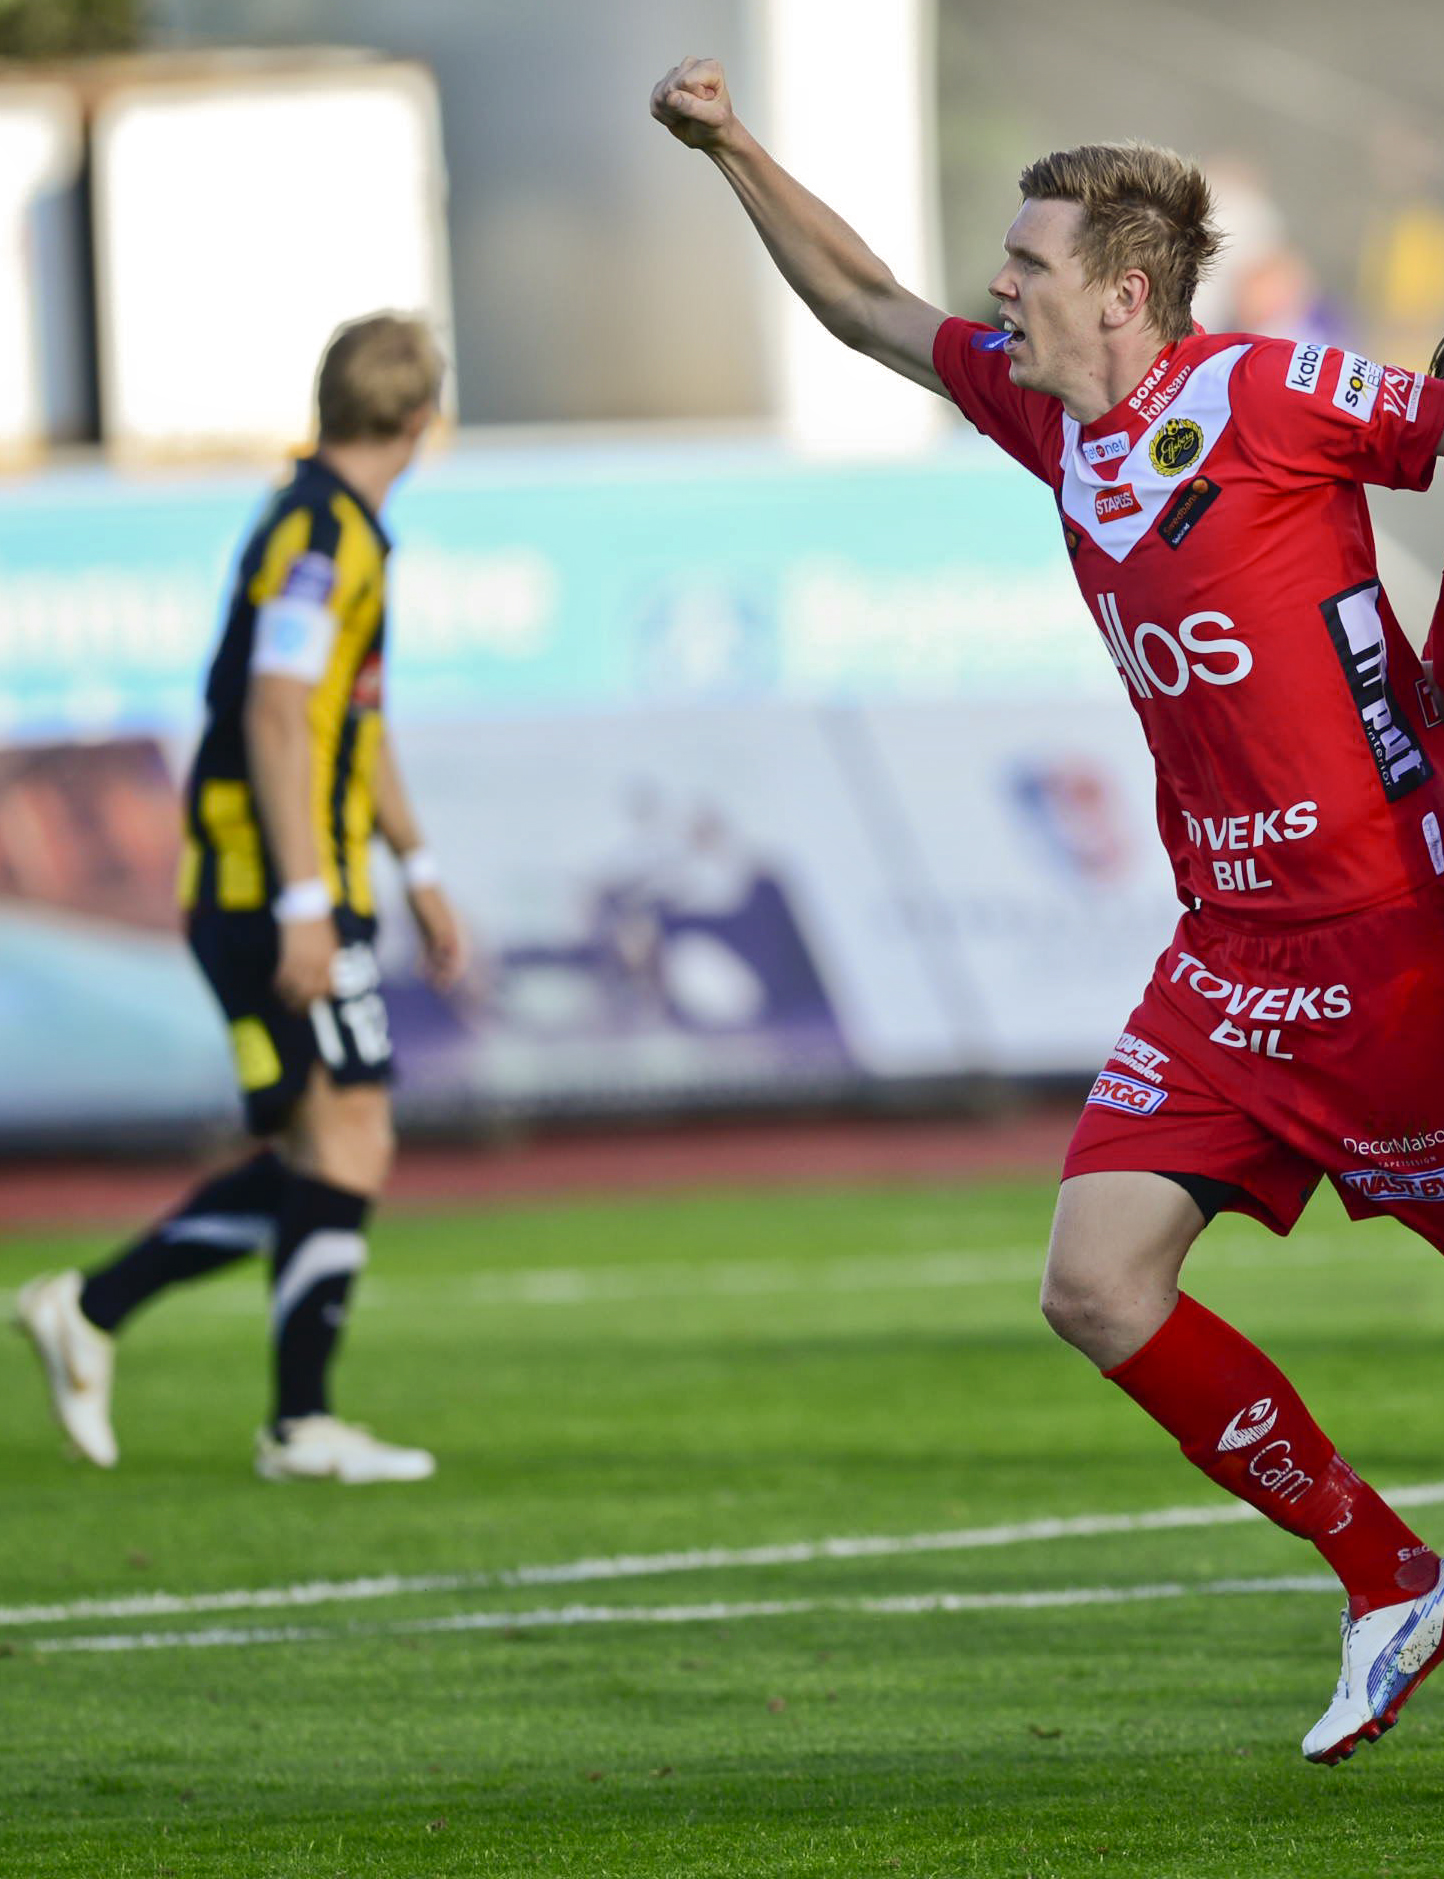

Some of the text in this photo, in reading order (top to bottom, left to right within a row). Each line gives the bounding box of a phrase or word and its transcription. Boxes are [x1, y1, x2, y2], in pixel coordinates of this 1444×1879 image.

[1137, 364, 1192, 425] Folksam
[1212, 857, 1273, 892] BIL
[1169, 951, 1352, 1022] TOVEKS
[1209, 1018, 1294, 1060] BIL
